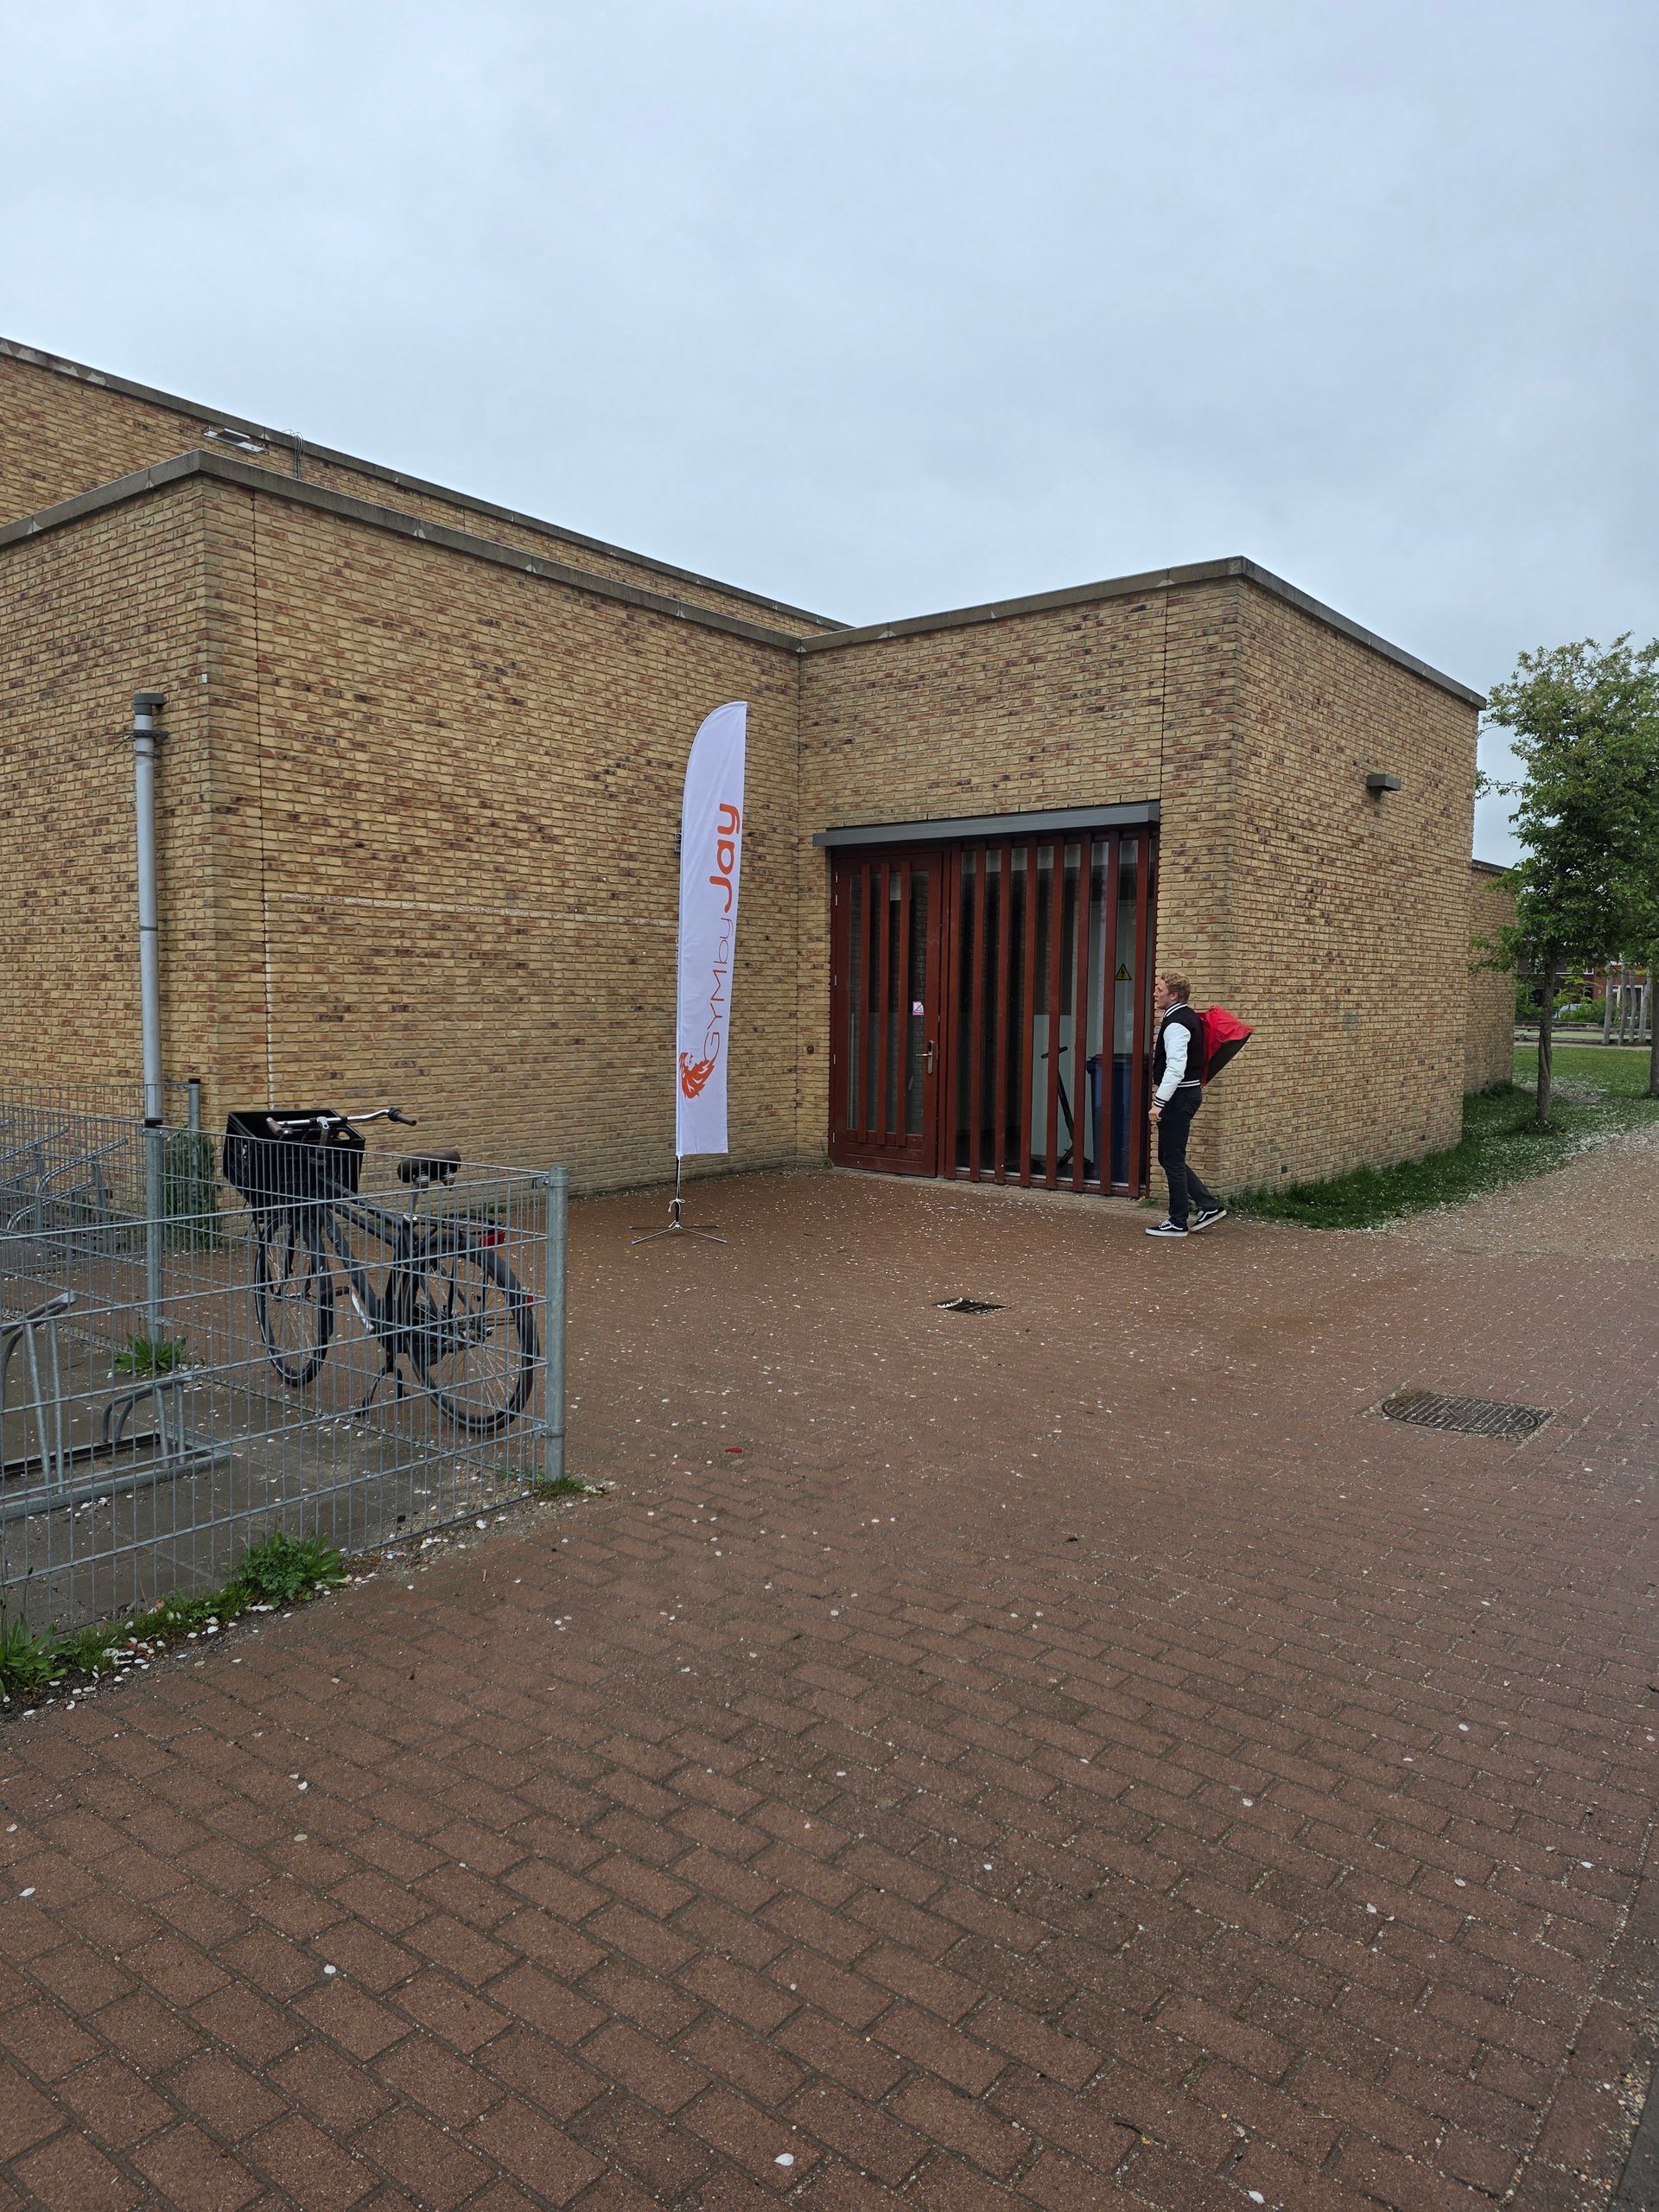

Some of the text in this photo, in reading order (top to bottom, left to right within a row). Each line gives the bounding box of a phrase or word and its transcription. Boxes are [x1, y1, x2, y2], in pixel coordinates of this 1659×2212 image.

[704, 804, 740, 1064] GYM by Jay
